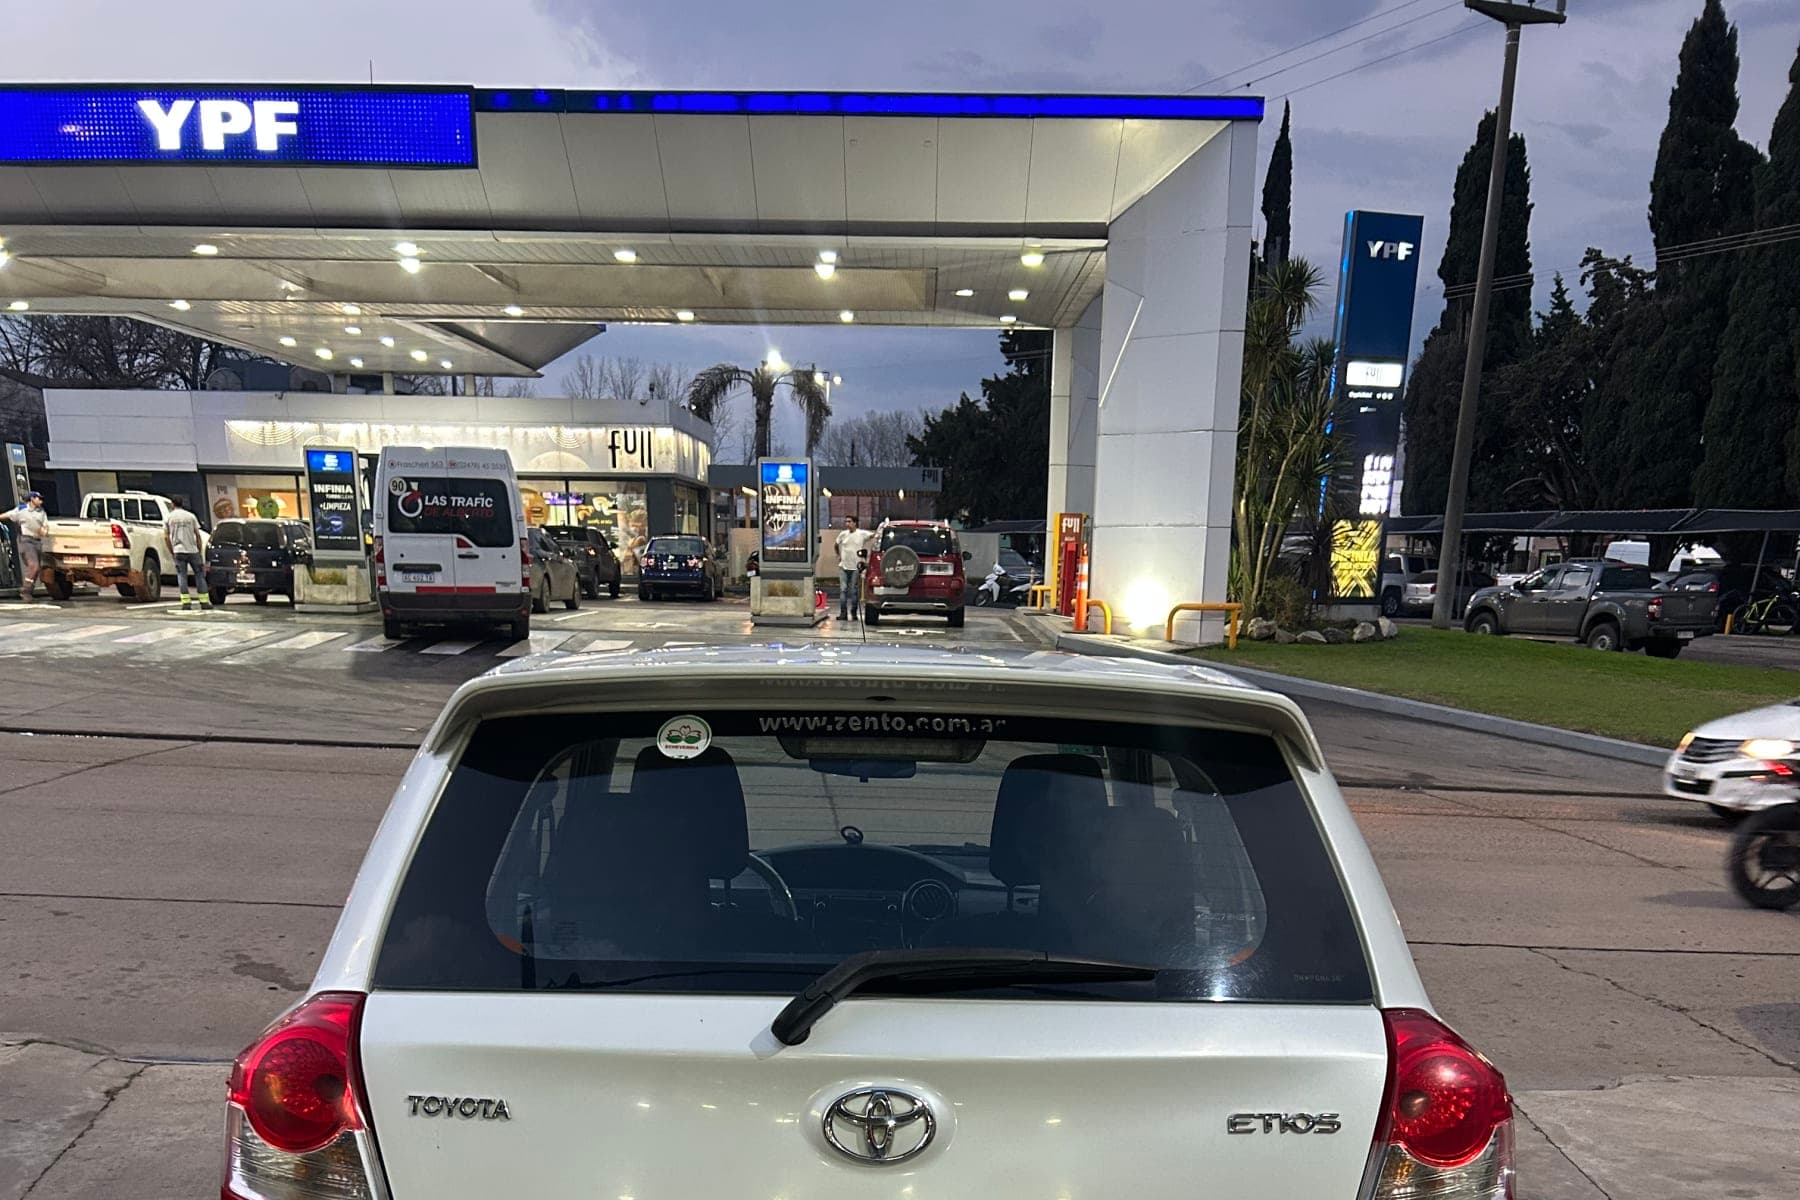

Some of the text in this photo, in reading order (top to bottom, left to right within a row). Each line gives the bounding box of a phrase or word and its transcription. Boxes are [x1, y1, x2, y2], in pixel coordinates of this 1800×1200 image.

[136, 99, 300, 152] YPF
[1367, 240, 1414, 261] YPF
[608, 430, 653, 469] full
[922, 469, 939, 483] full
[313, 484, 354, 494] INFINIA
[391, 481, 405, 492] 90
[424, 496, 448, 506] LAS
[765, 495, 805, 505] INFINIA
[1061, 517, 1081, 534] full
[407, 1095, 512, 1121] TOYOTA
[1227, 1112, 1342, 1135] ETIOS
